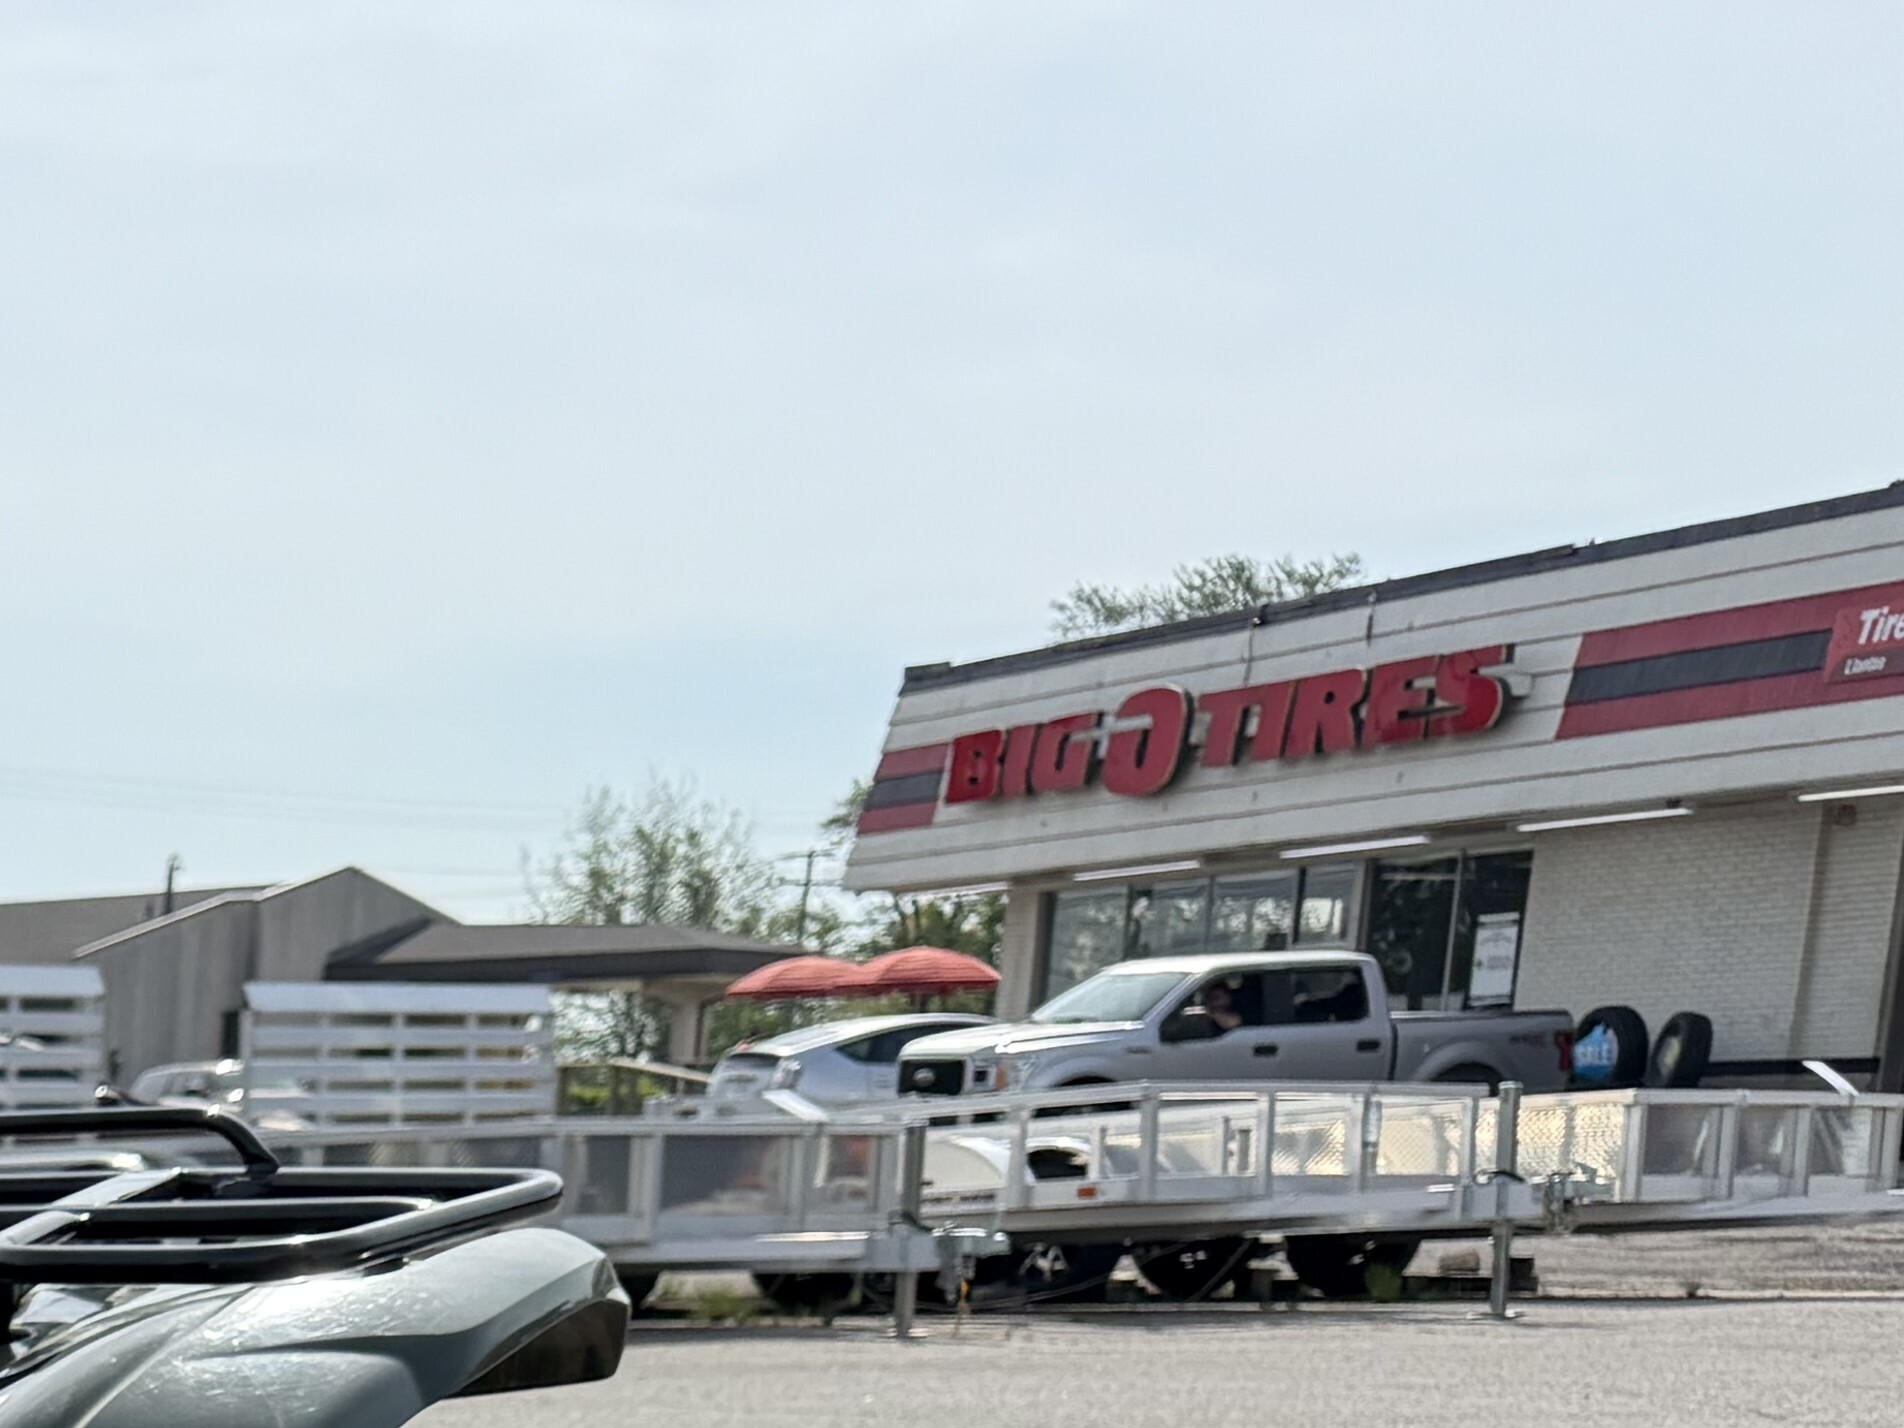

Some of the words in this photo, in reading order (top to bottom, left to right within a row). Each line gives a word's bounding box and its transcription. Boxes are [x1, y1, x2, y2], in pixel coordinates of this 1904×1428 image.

[945, 710, 1103, 804] BIG
[1100, 683, 1191, 797] O
[1197, 643, 1510, 769] TIRES
